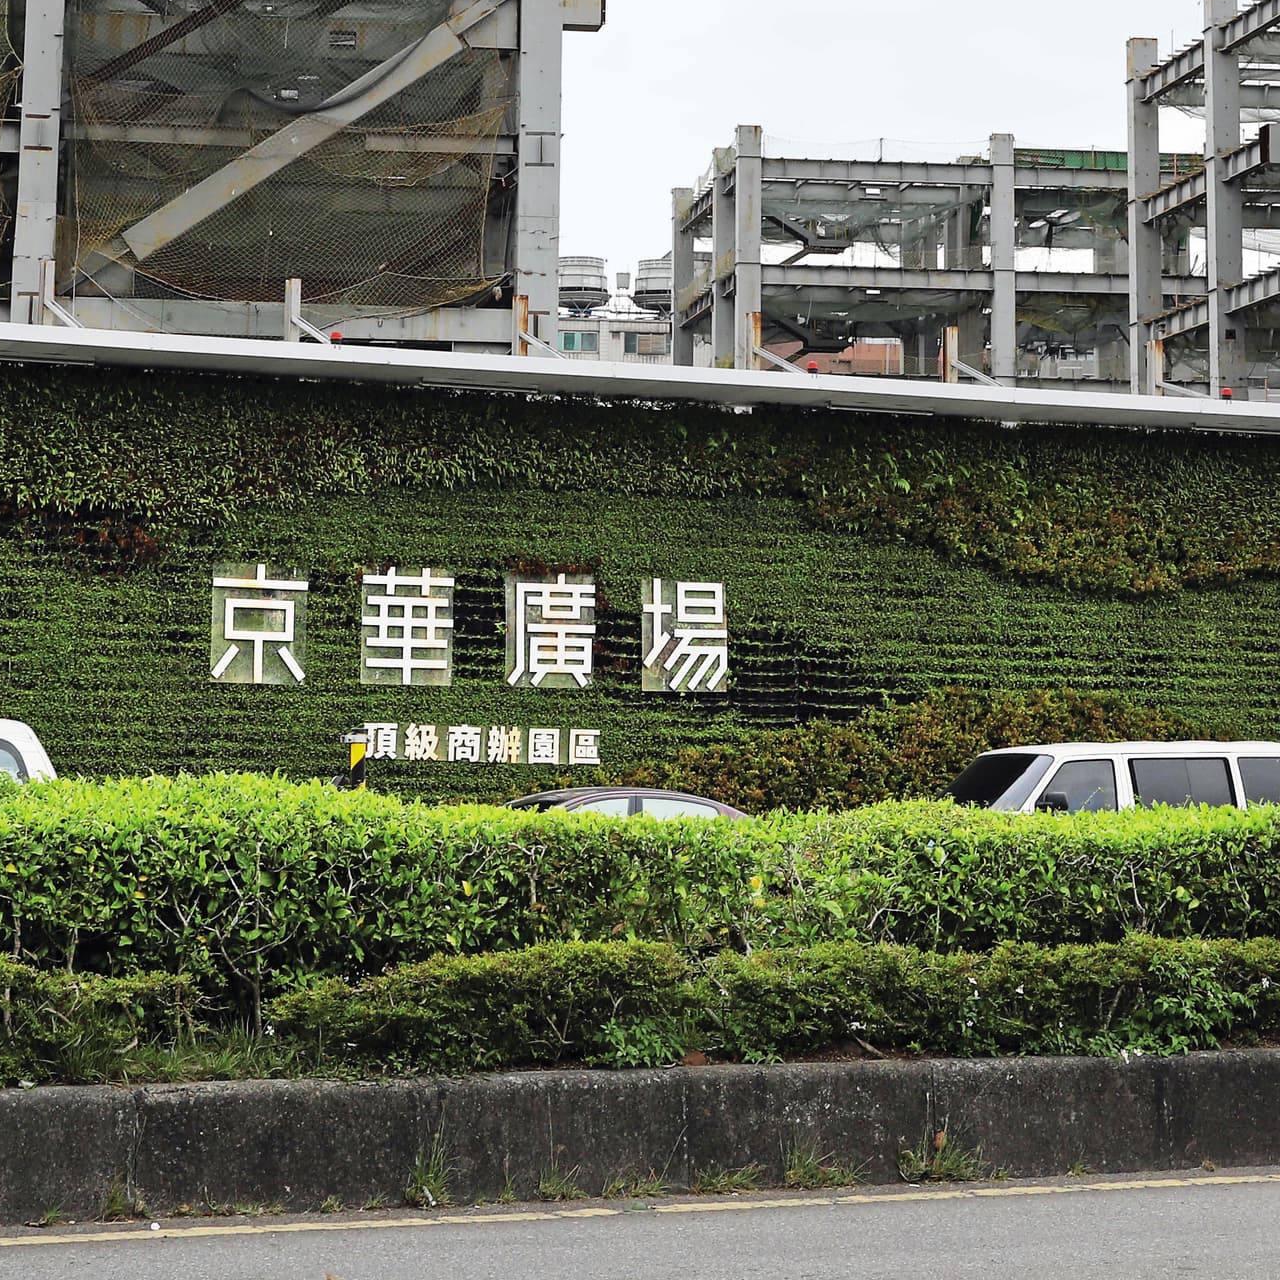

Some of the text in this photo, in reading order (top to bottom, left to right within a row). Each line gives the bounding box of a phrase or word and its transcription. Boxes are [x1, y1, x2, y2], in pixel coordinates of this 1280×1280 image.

[211, 563, 728, 691] 京華廣場
[364, 722, 601, 765] 頂級商辦園區
